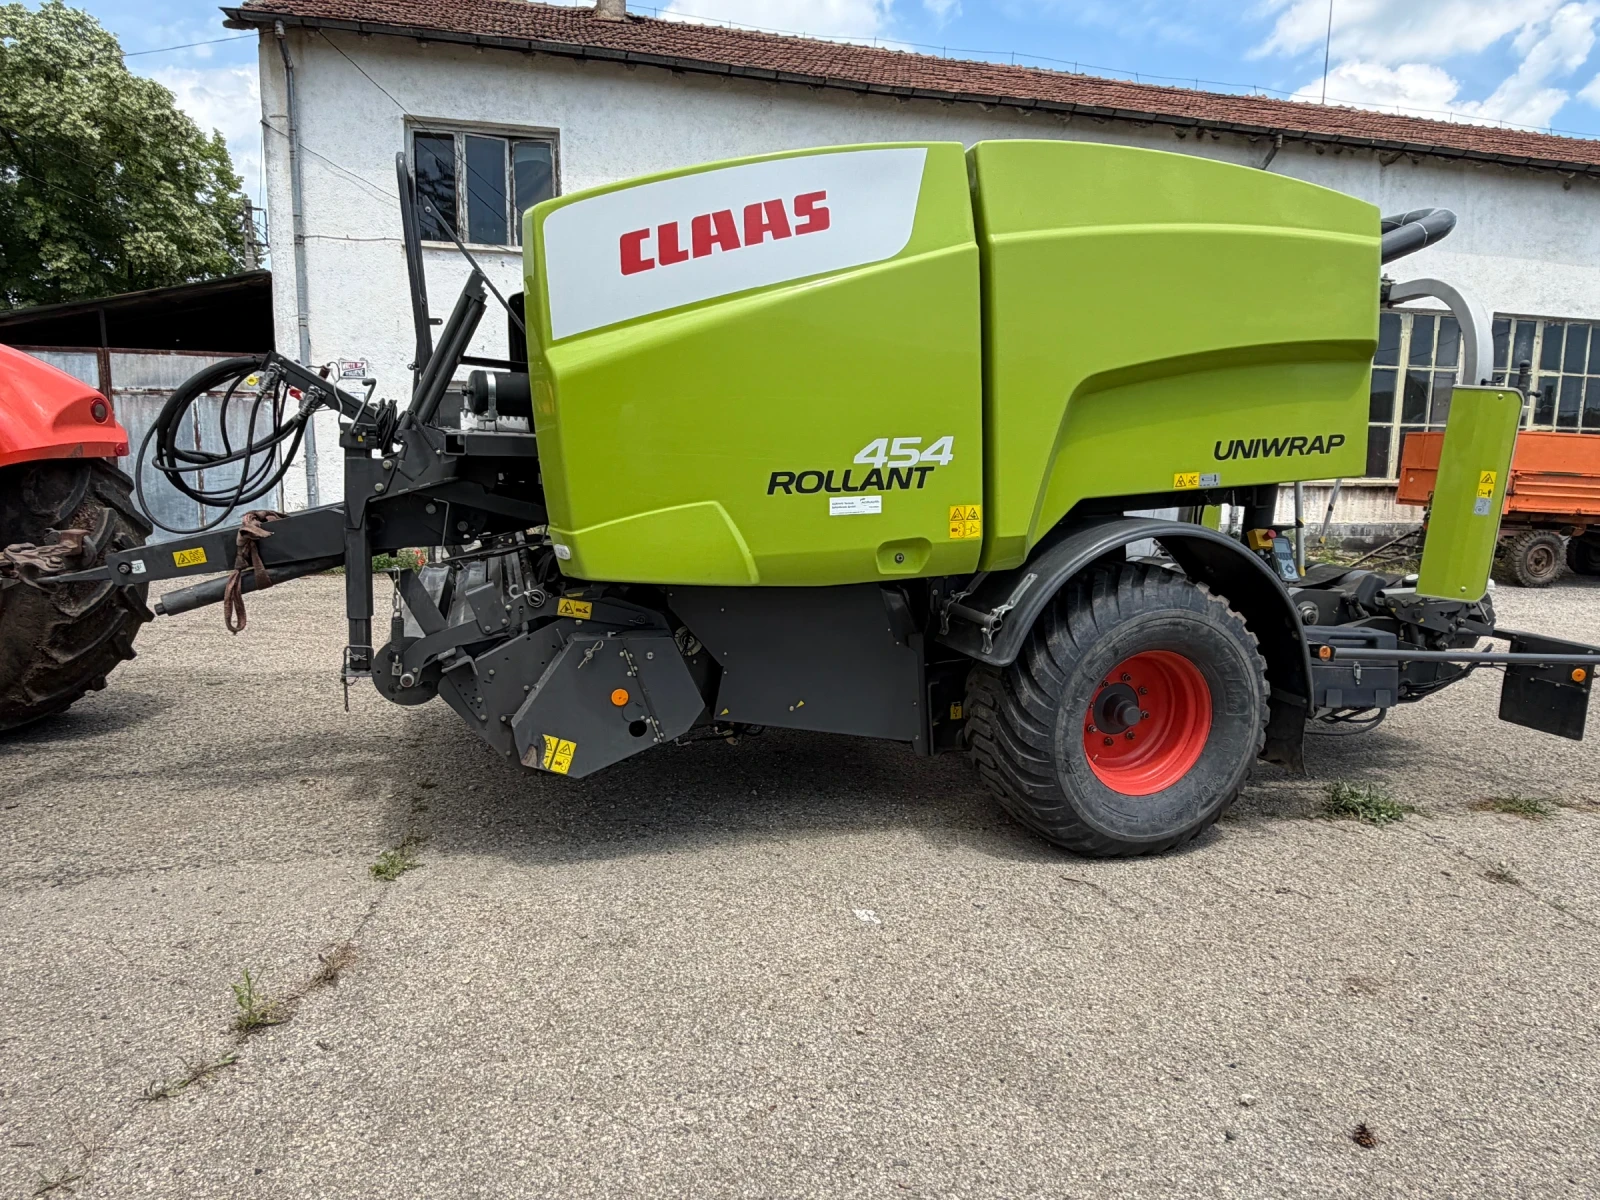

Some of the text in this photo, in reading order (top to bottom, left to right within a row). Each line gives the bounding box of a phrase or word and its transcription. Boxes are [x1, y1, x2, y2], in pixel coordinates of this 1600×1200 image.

[619, 190, 831, 276] CLAAS
[853, 436, 954, 468] 454
[1213, 434, 1346, 461] UNIWRAP
[766, 466, 935, 495] ROLLANT
